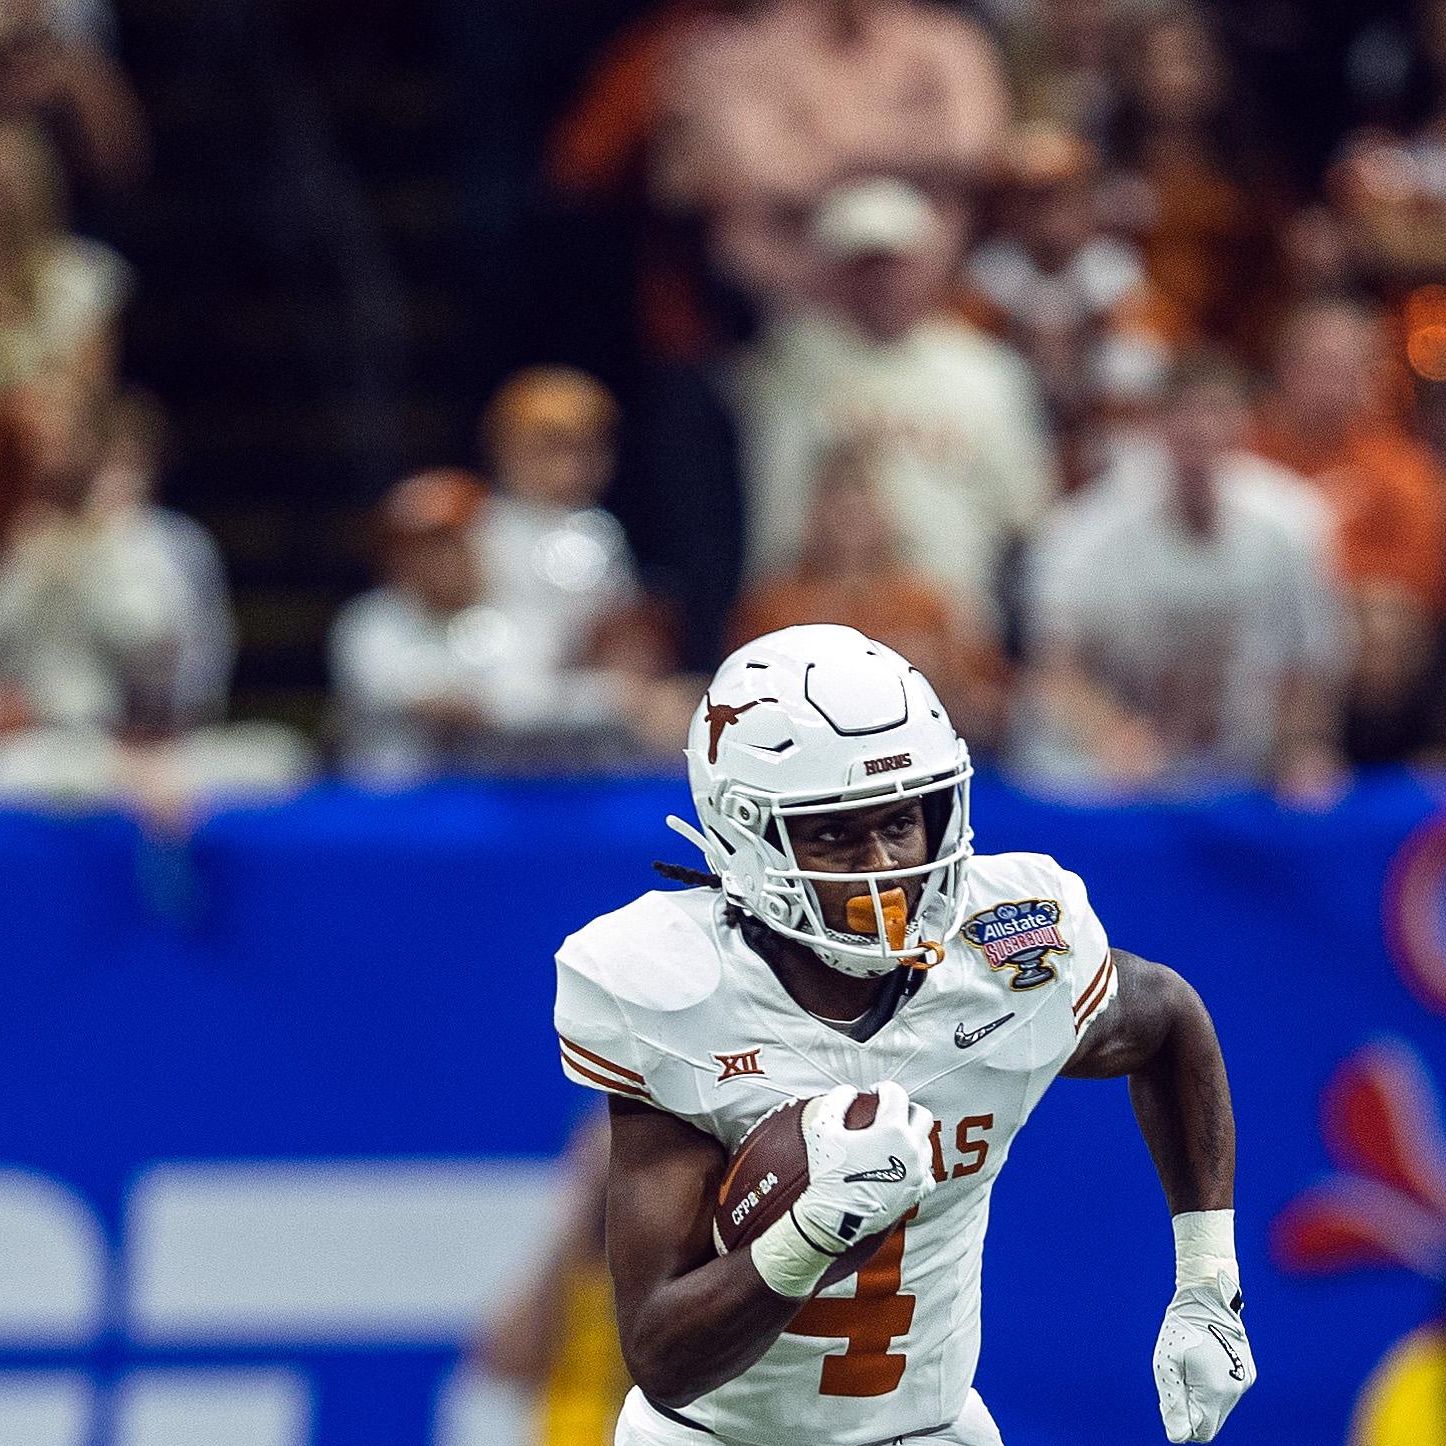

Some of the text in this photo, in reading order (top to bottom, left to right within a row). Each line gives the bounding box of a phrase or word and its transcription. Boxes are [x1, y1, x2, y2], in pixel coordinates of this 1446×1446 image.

[863, 752, 913, 777] HORNS
[984, 914, 1048, 941] Allstate
[714, 1047, 766, 1082] XII
[781, 1202, 920, 1399] 4
